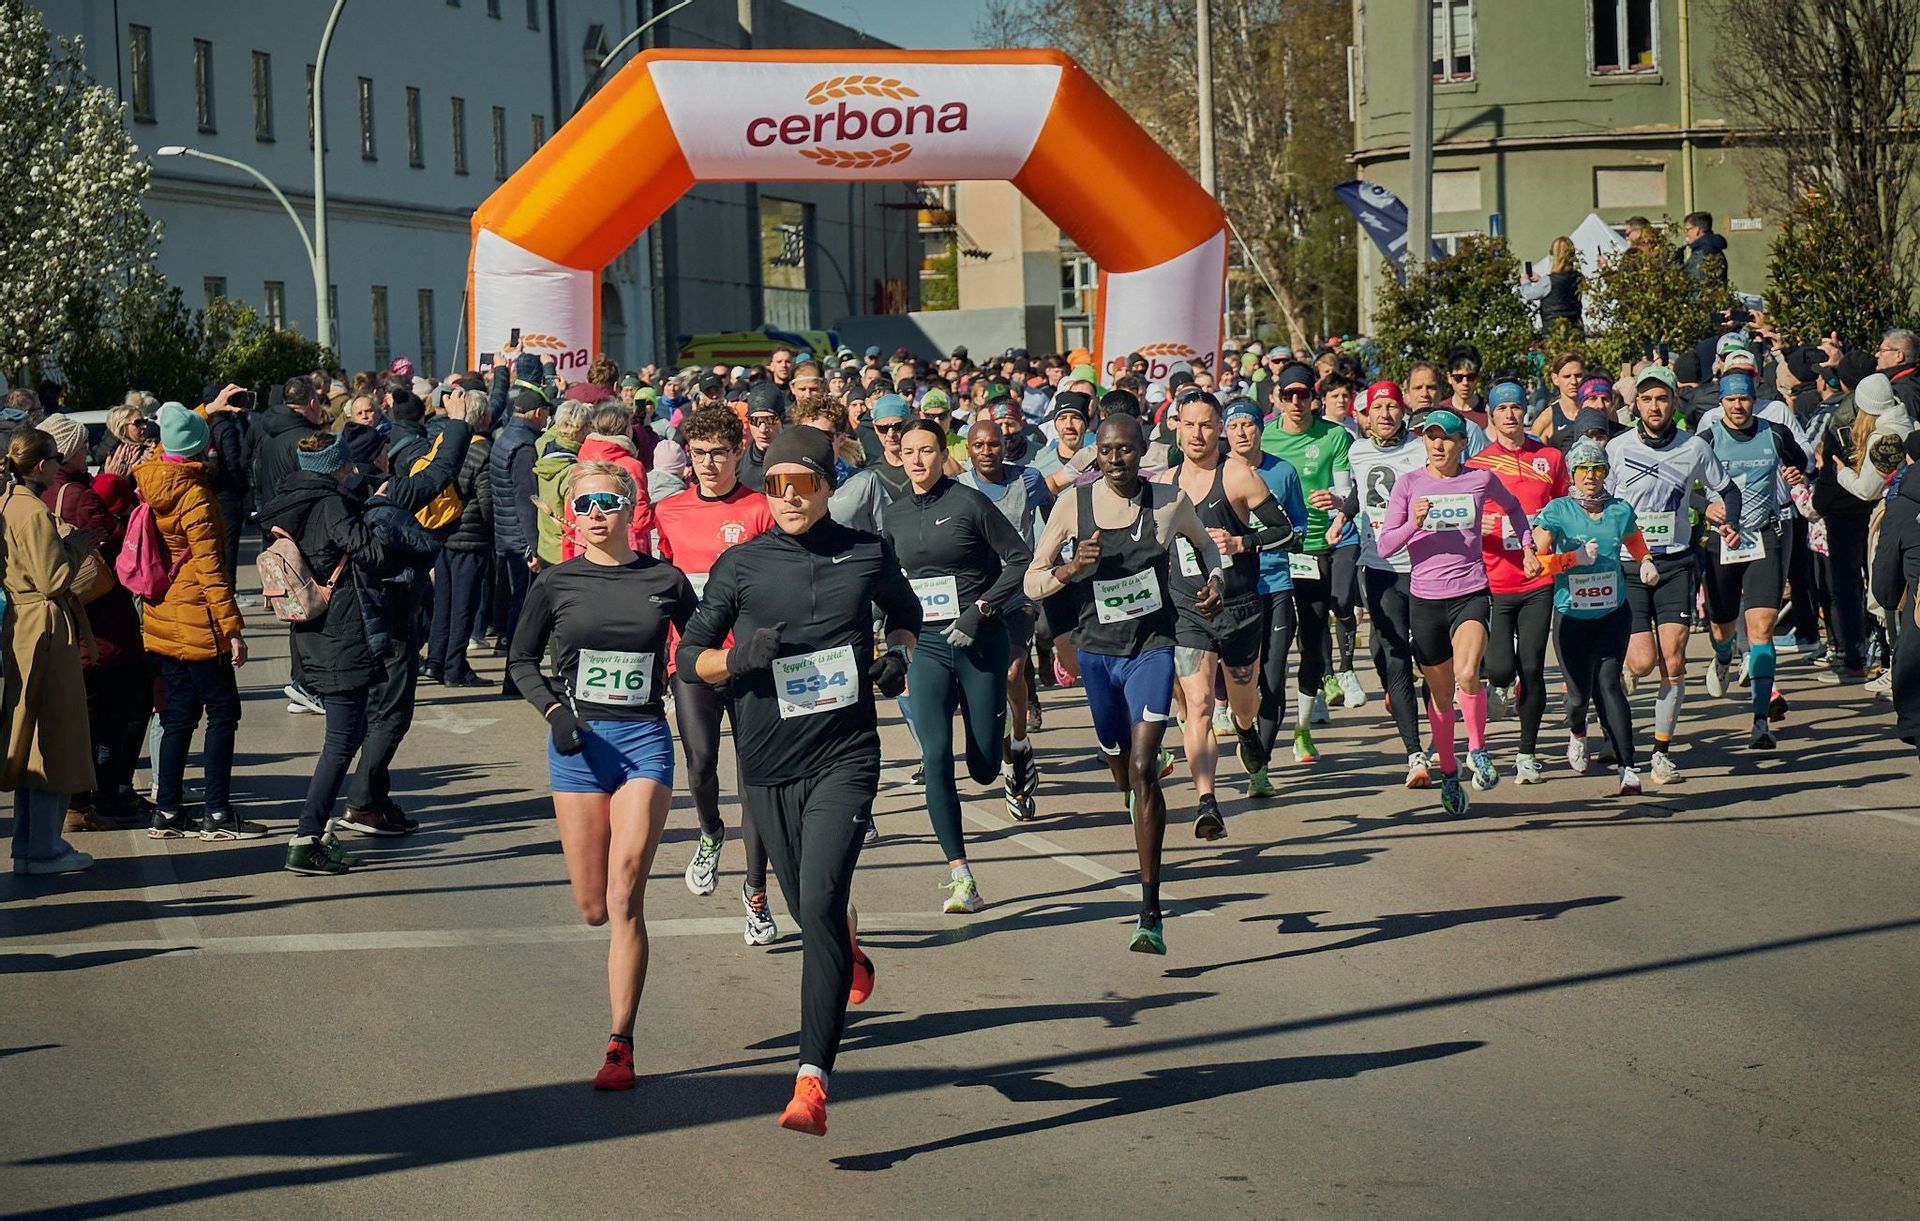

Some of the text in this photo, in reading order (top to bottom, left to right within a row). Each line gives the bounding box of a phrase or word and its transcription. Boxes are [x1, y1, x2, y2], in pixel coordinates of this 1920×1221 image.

[746, 101, 968, 147] cerbona
[1428, 507, 1468, 519] 608
[1103, 588, 1153, 608] 014
[1575, 586, 1613, 598] 480
[586, 667, 644, 690] 216
[786, 670, 848, 695] 534
